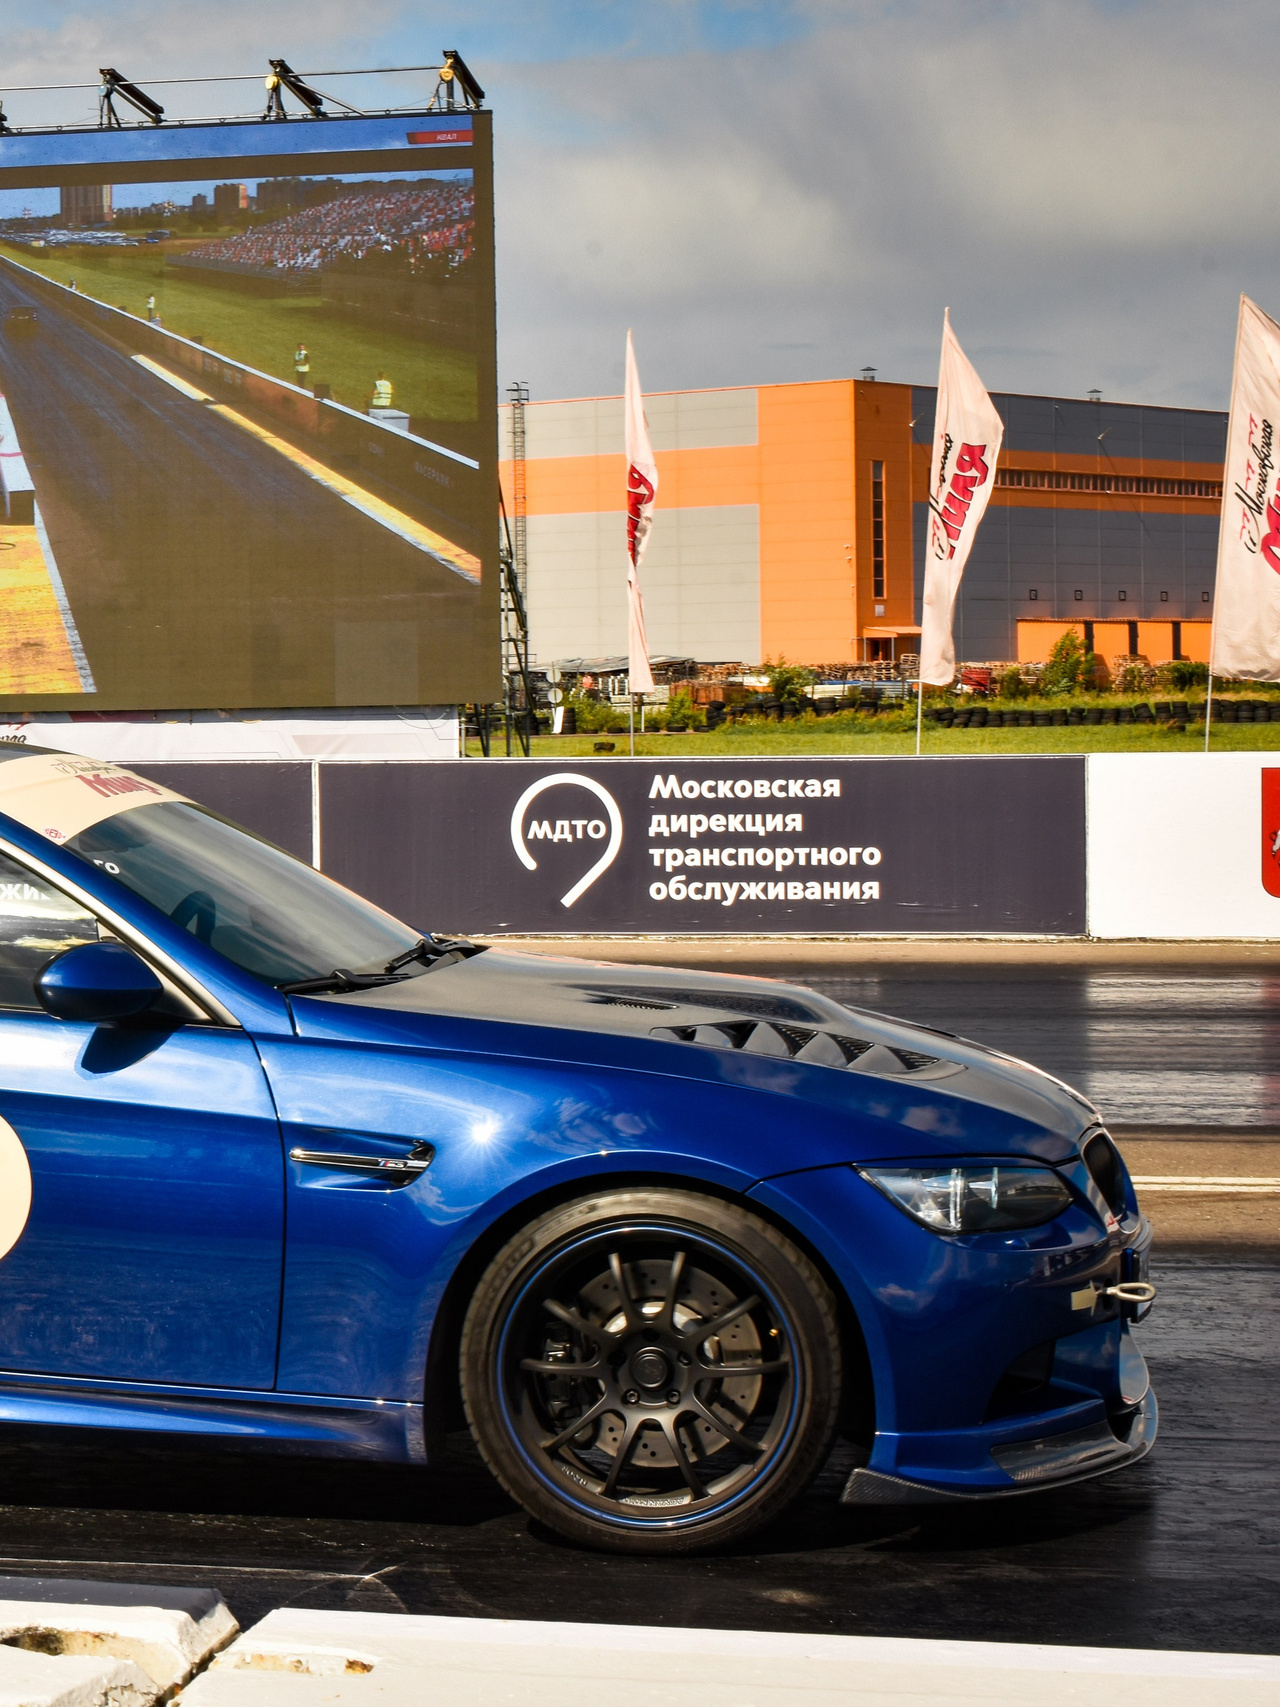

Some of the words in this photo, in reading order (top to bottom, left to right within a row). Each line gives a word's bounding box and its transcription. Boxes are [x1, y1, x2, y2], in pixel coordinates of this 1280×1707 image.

[648, 774, 841, 799] Московская
[527, 818, 606, 842] МДТО
[648, 813, 803, 838] дирекция
[648, 845, 881, 872] транспортного
[648, 874, 880, 906] обслуживания
